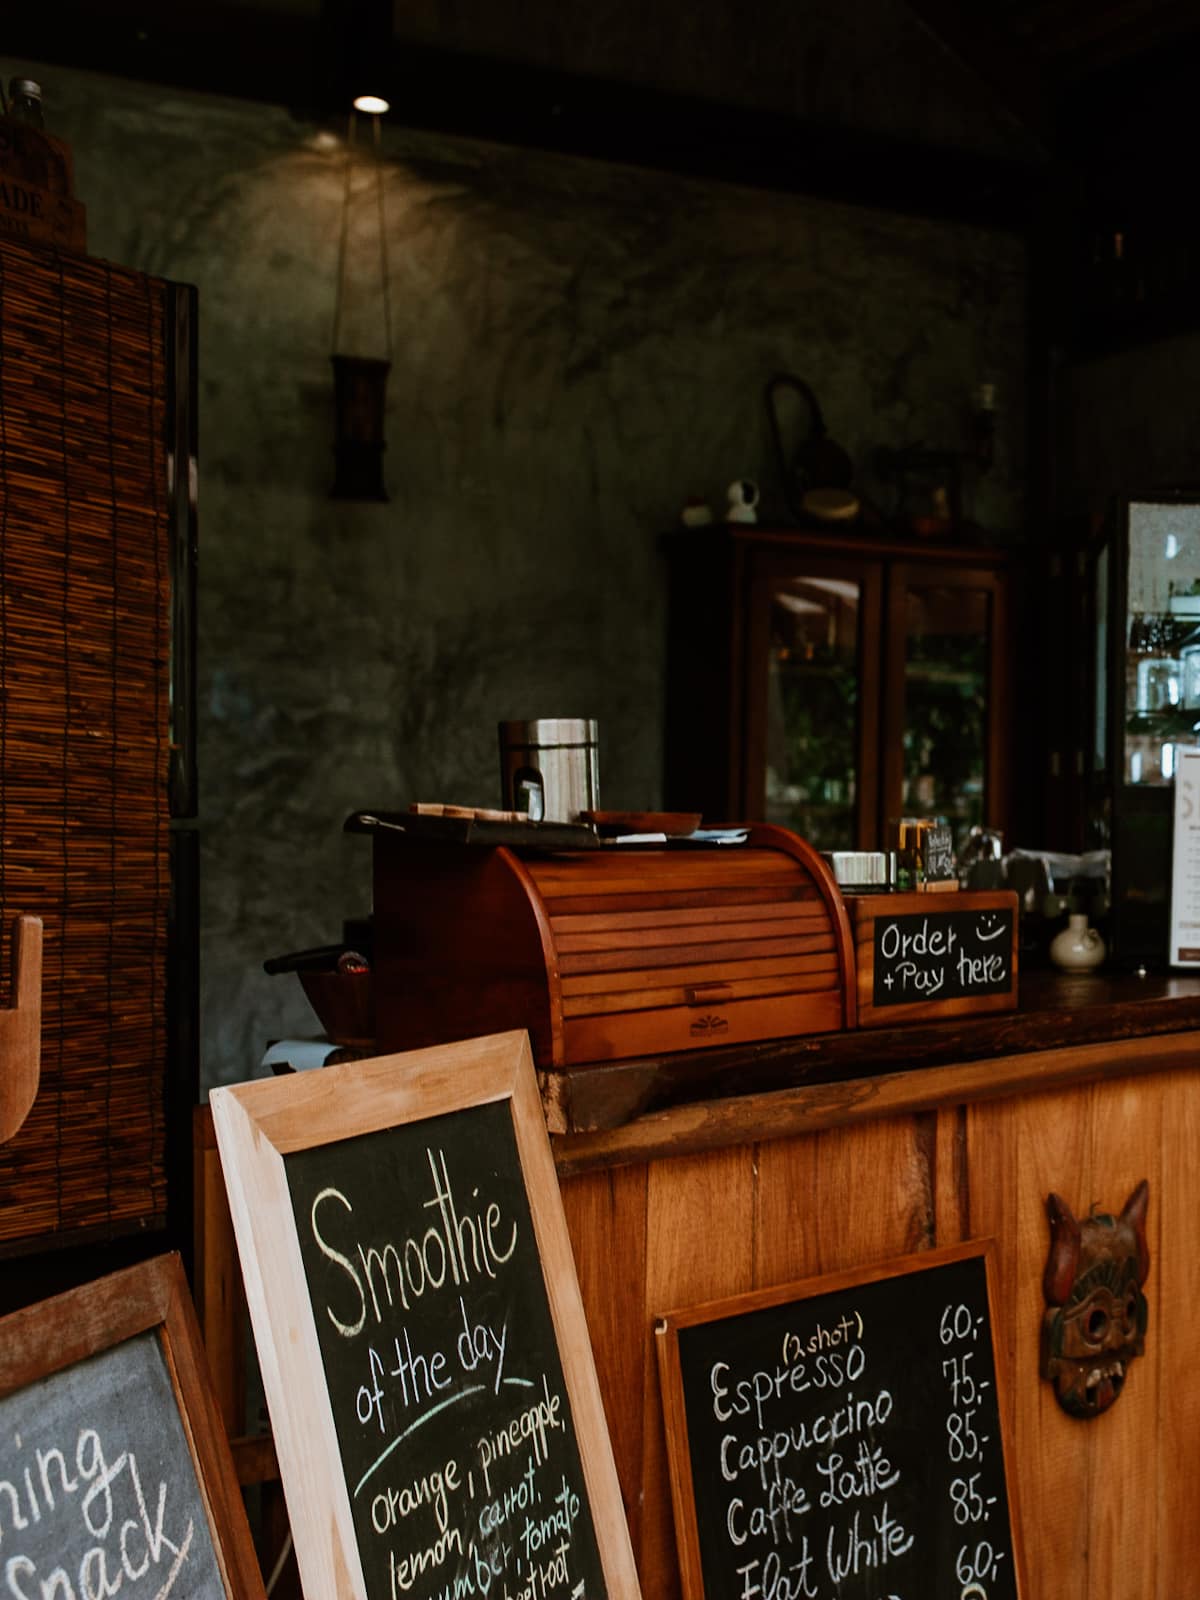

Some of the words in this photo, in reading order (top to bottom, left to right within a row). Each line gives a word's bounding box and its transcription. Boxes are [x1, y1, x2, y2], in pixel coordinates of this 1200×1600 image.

[881, 919, 956, 958] Order
[956, 947, 1006, 986] here
[311, 1148, 518, 1338] Smoothie
[356, 1347, 386, 1433] of
[391, 1327, 452, 1407] the
[457, 1296, 507, 1396] day
[711, 1345, 865, 1430] Espresso
[720, 1390, 893, 1490] Cappuccino
[520, 1475, 580, 1560] tomato
[736, 1536, 818, 1600] Flat
[827, 1501, 914, 1584] White
